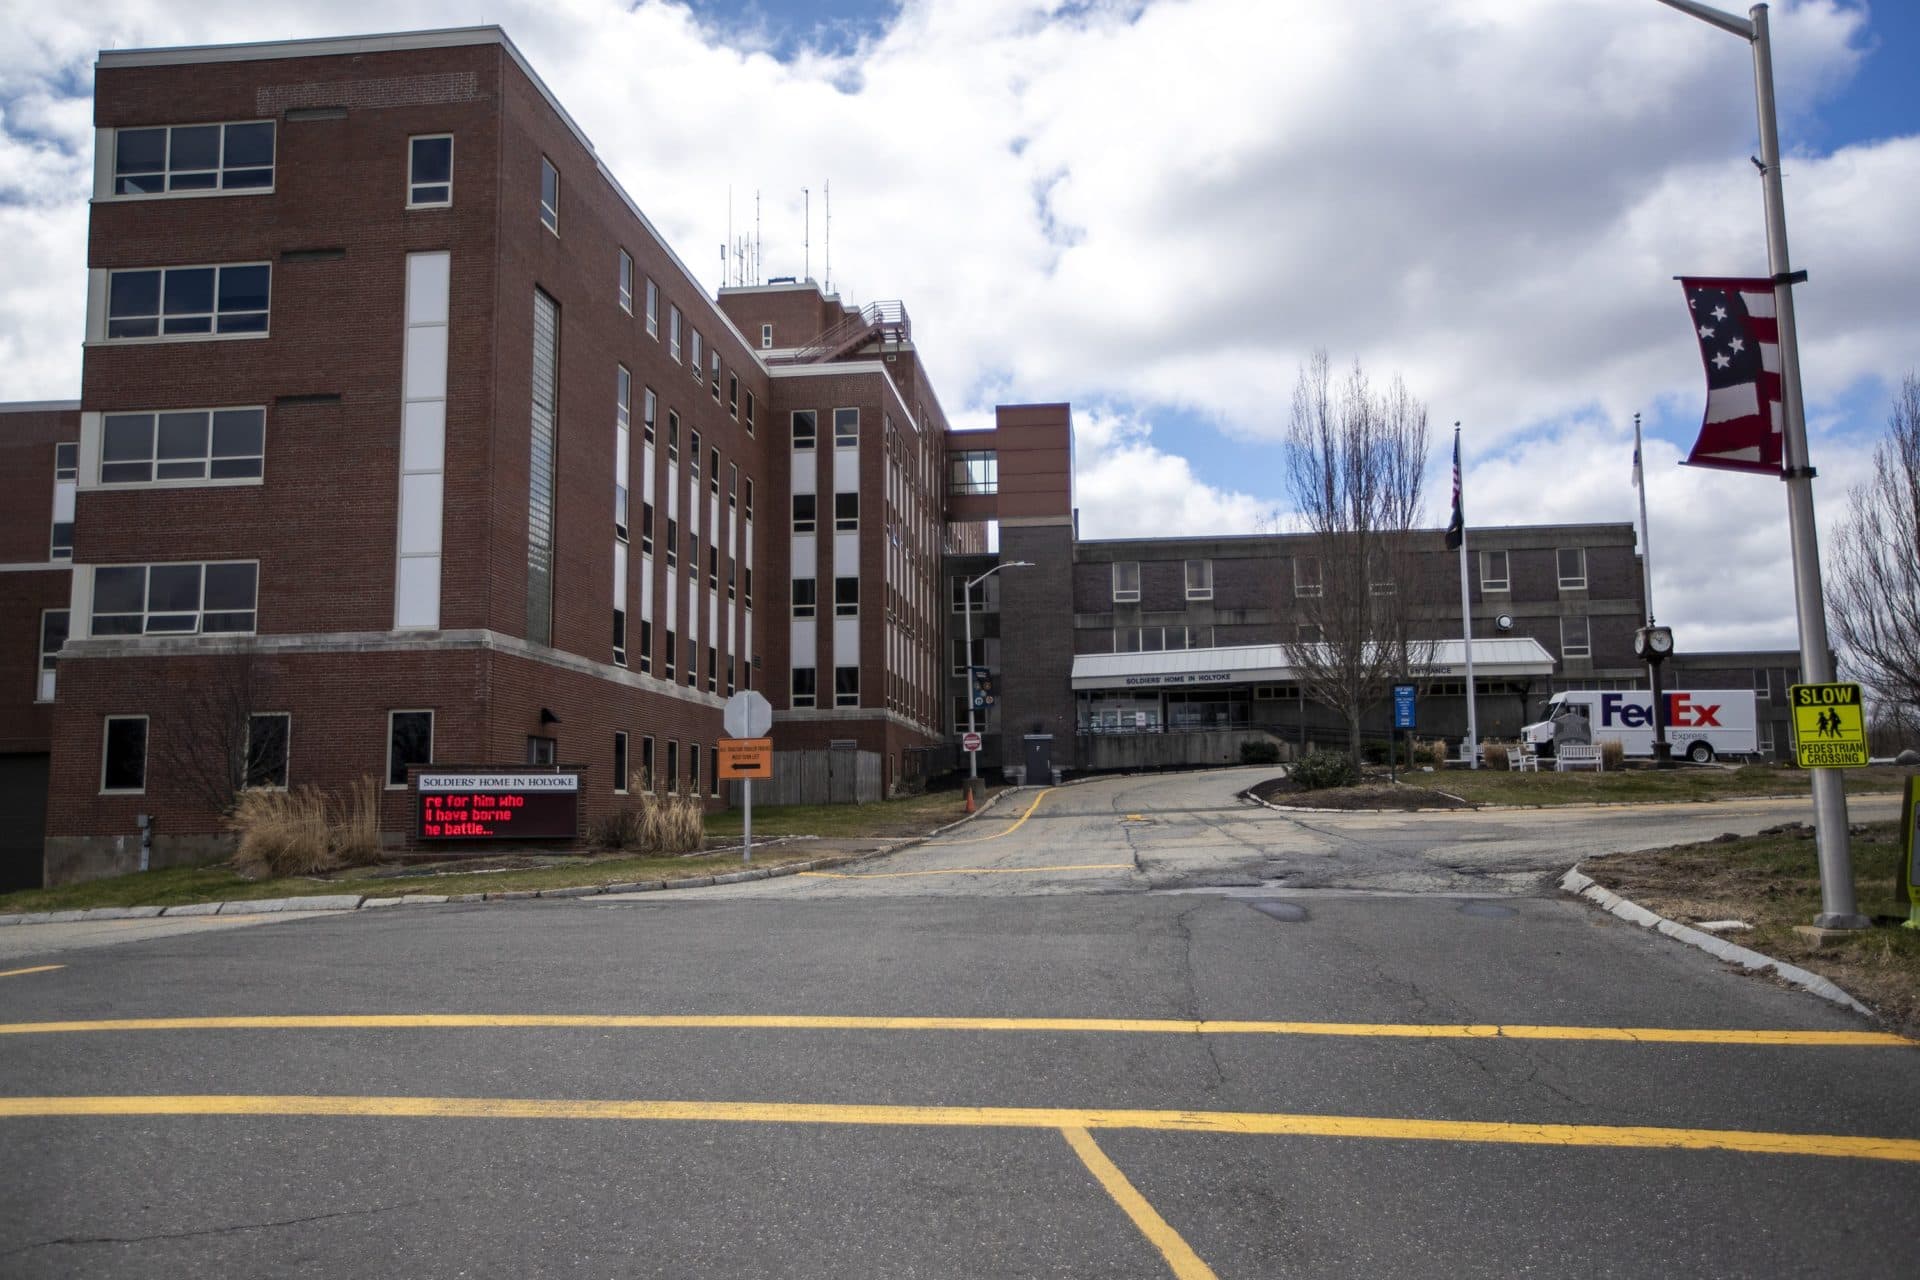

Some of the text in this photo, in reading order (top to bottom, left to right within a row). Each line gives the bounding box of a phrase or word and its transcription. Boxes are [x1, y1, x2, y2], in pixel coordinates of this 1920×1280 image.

[1126, 676, 1161, 685] SOLDIERS'
[1164, 674, 1184, 683] HOME
[1199, 673, 1231, 681] HOLYOKE
[1800, 687, 1852, 704] SLOW
[1601, 693, 1722, 728] FedEx
[1671, 731, 1708, 740] Express
[1801, 743, 1863, 753] PEDESTRIAN
[1807, 752, 1859, 763] CROSSING
[423, 778, 574, 787] SOLDIERS' HOME IN HOLYOKE
[425, 794, 524, 807] re for him who
[436, 809, 467, 821] have
[472, 809, 512, 821] borne
